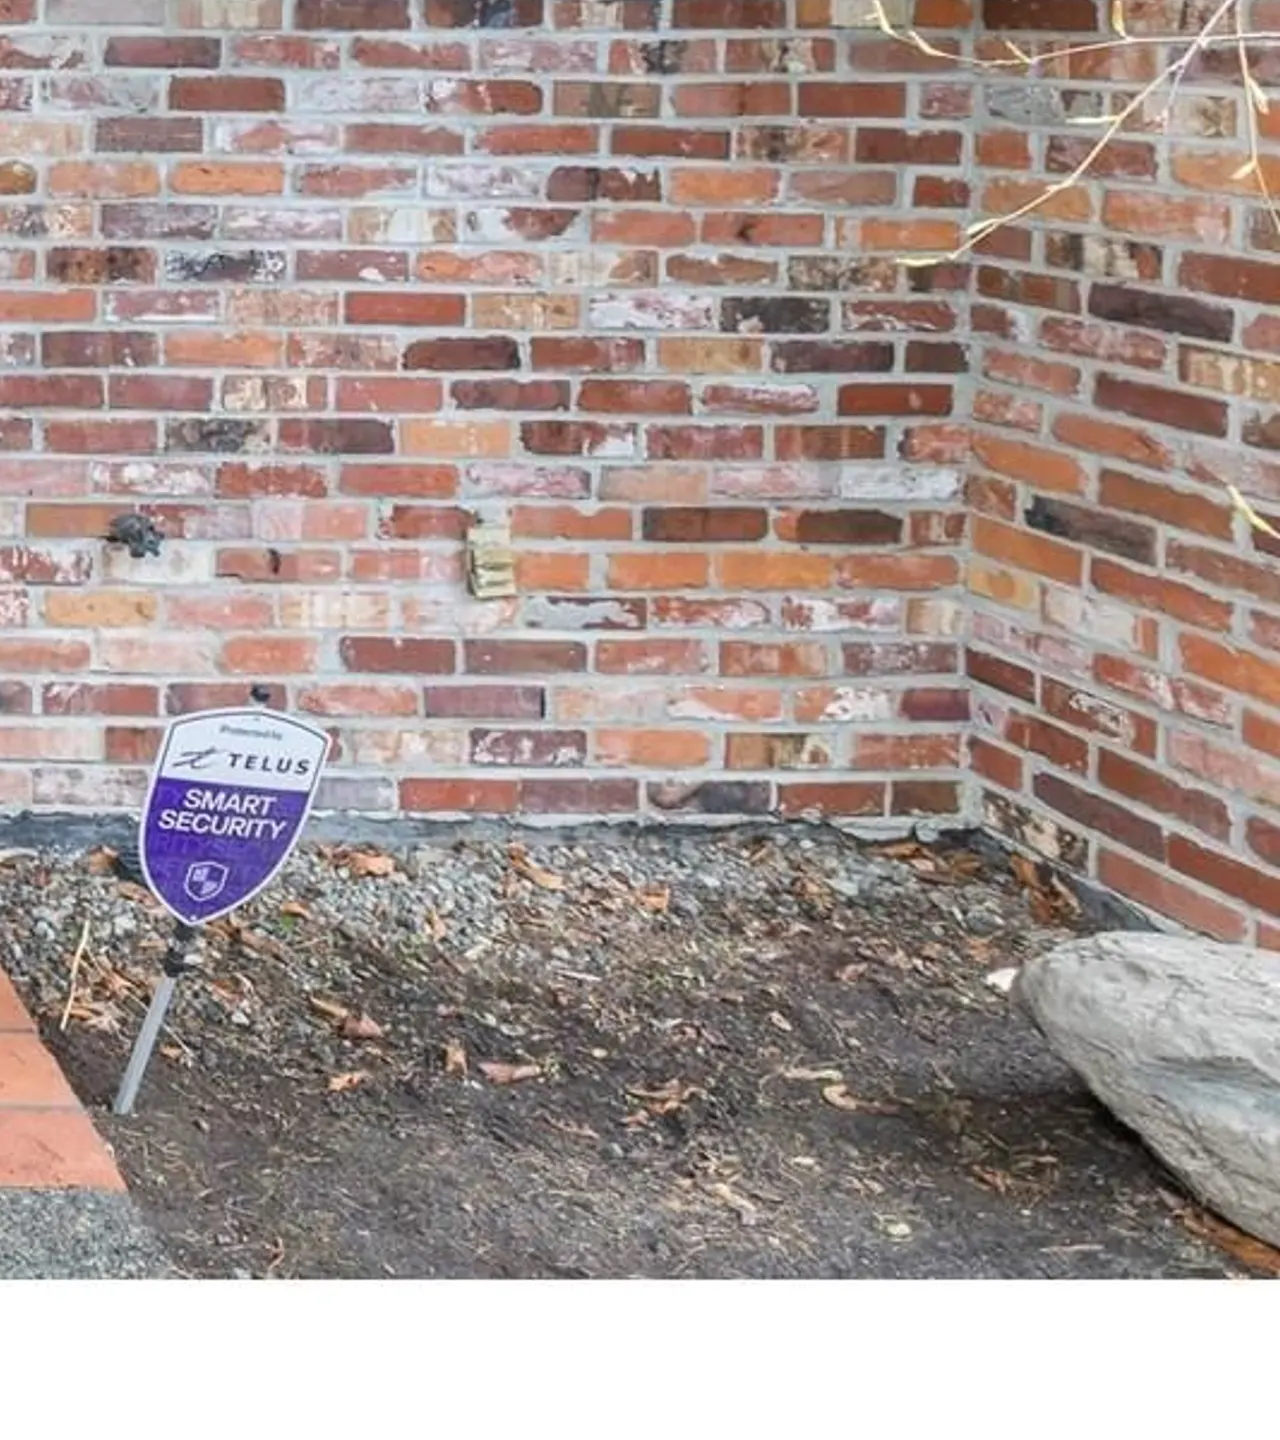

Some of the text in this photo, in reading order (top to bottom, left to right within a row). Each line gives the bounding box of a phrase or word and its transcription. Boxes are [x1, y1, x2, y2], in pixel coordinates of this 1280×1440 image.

[229, 752, 310, 775] TELUS
[183, 788, 277, 818] SMART
[157, 809, 287, 840] SECURITY
